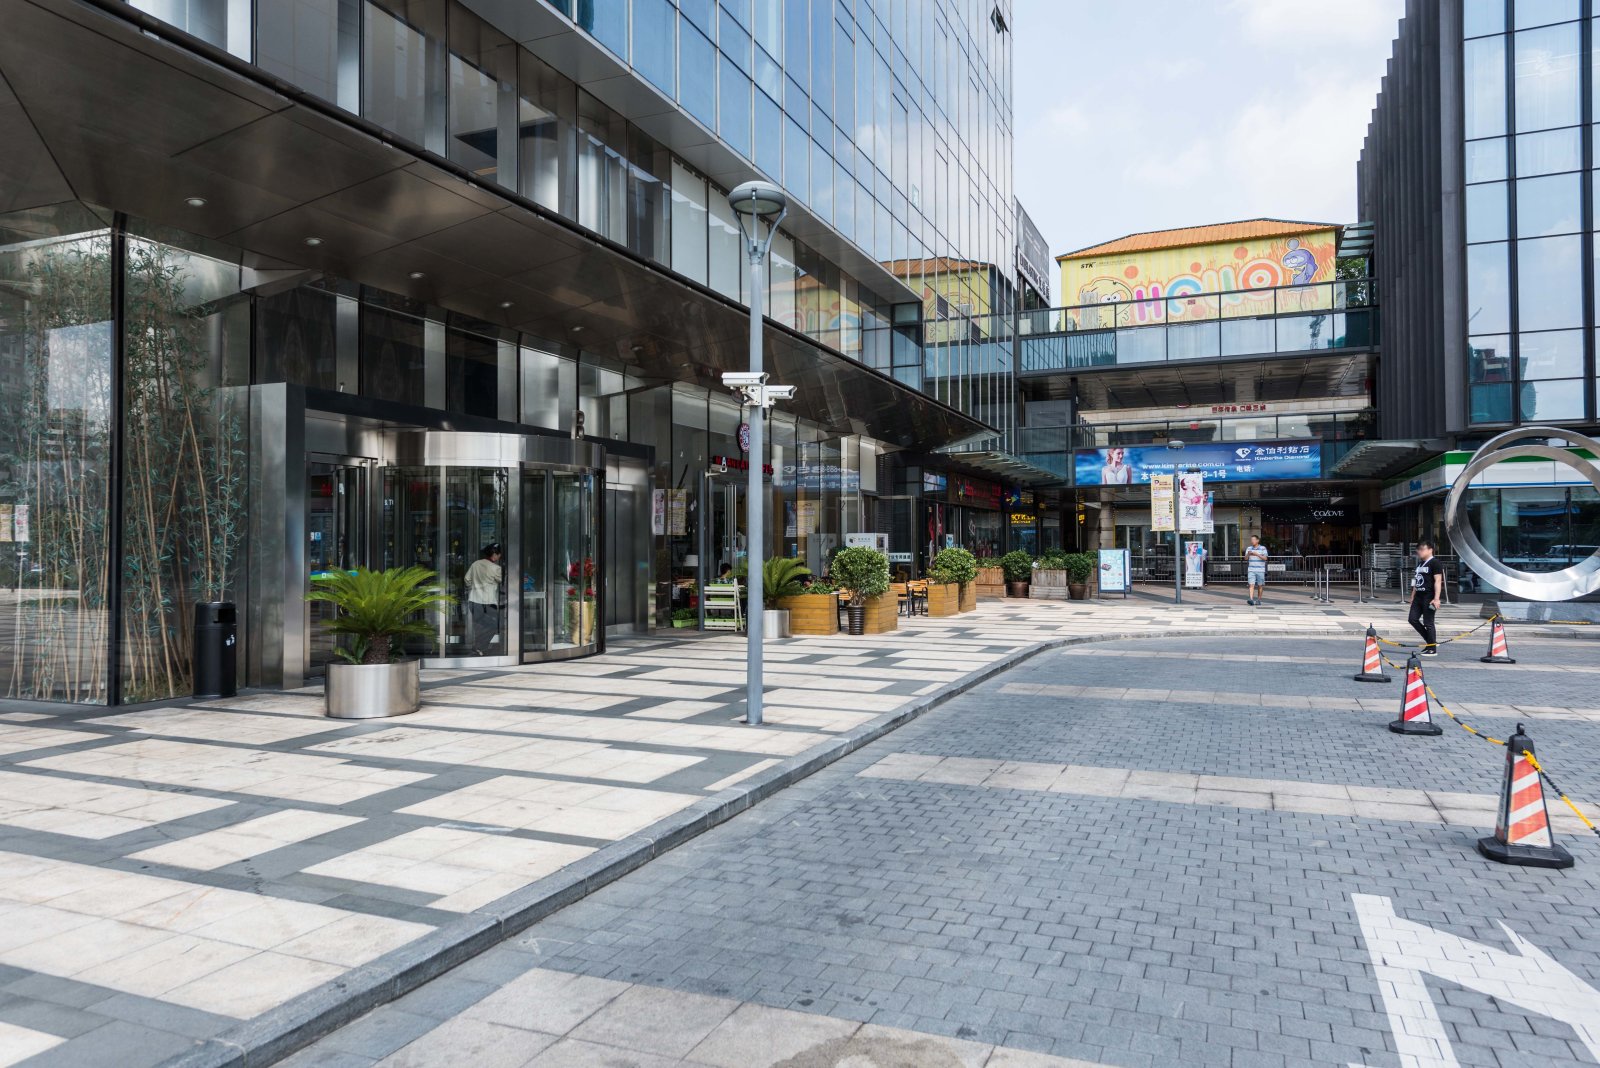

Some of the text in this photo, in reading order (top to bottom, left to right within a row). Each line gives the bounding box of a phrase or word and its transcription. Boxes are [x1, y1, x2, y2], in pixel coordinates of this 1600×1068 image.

[571, 410, 585, 440] B
[1255, 445, 1310, 456] 金伯利钻石
